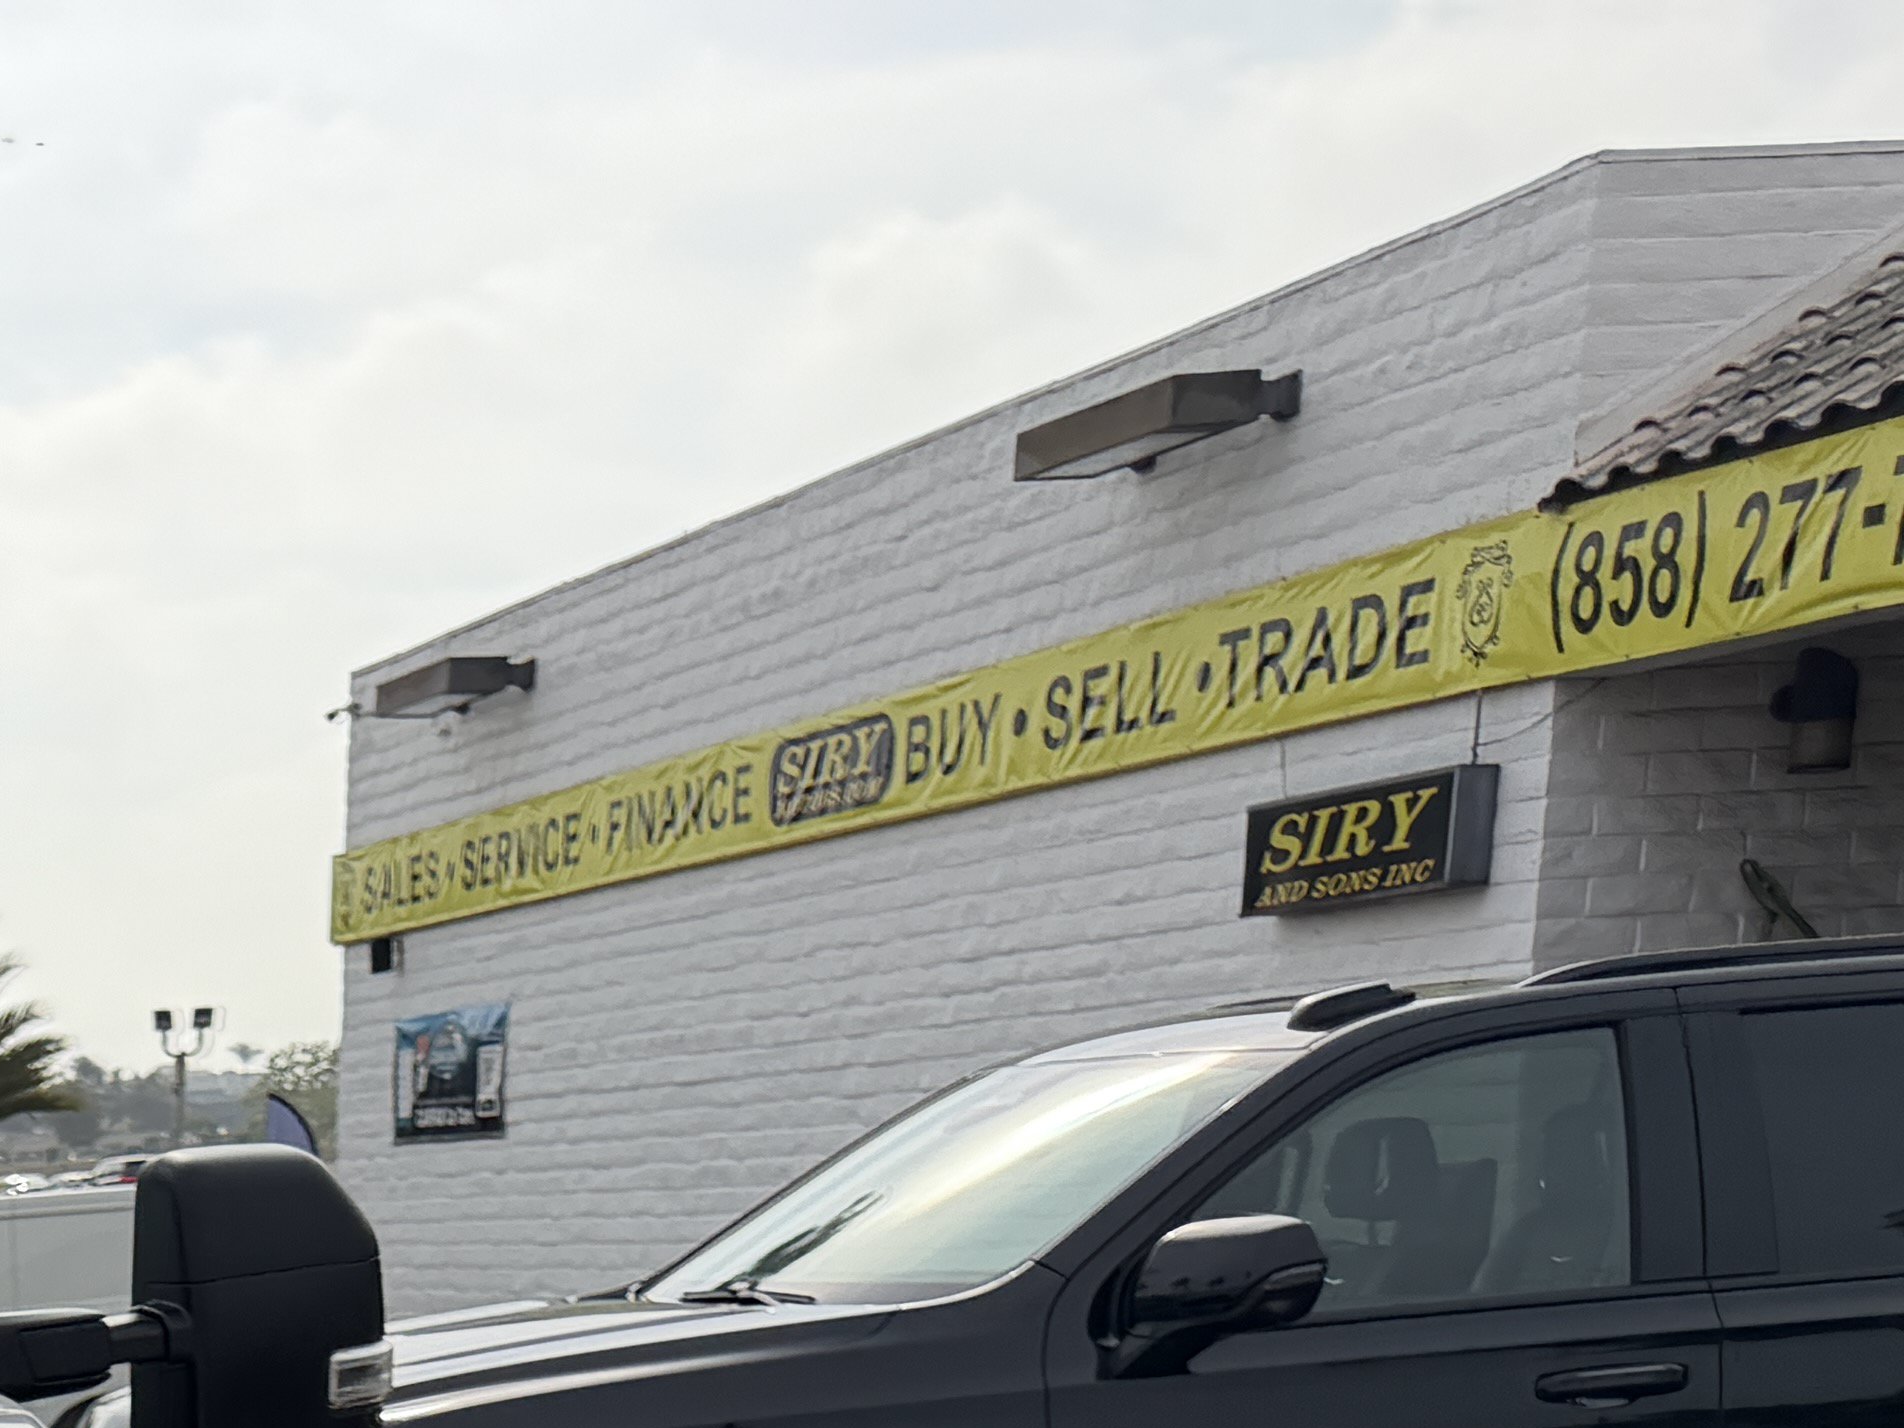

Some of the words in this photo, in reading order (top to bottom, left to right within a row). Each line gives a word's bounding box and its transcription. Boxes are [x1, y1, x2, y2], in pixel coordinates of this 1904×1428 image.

[1551, 489, 1706, 653] (858)
[906, 692, 1001, 784] BUY
[1042, 651, 1176, 750] SELL
[1218, 576, 1436, 709] TRADE
[776, 721, 890, 794] SIRY
[363, 851, 440, 914] SALES
[461, 812, 582, 892] SERVICE
[606, 763, 754, 856] FINANCE
[1254, 879, 1310, 908] AND
[1311, 867, 1384, 899] SONS
[1382, 858, 1436, 888] INC
[1260, 786, 1439, 874] SIRY
